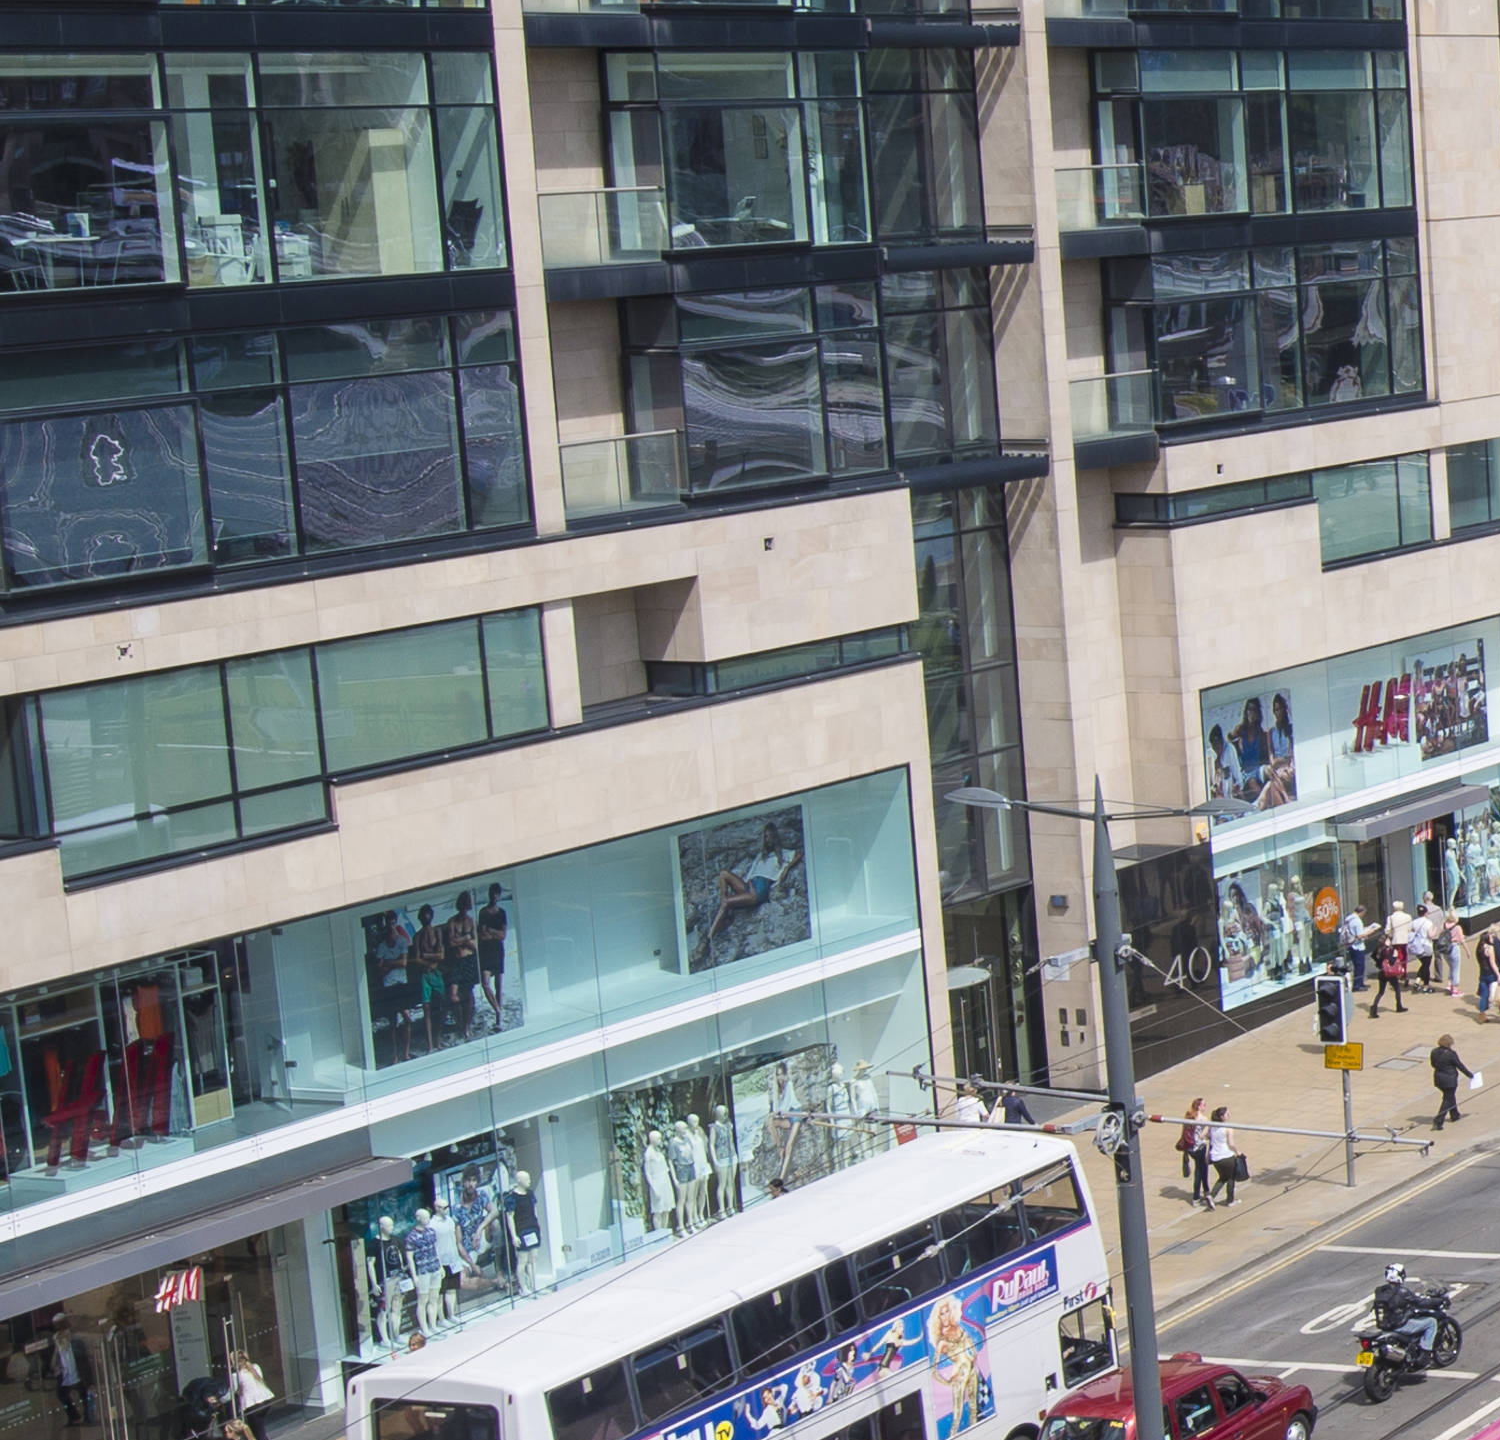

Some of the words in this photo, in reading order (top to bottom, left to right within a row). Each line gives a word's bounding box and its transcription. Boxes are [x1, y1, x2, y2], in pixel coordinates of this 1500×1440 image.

[1163, 946, 1212, 989] 40
[154, 1265, 202, 1313] H&M
[1063, 1289, 1085, 1311] First
[717, 1426, 731, 1440] TV
